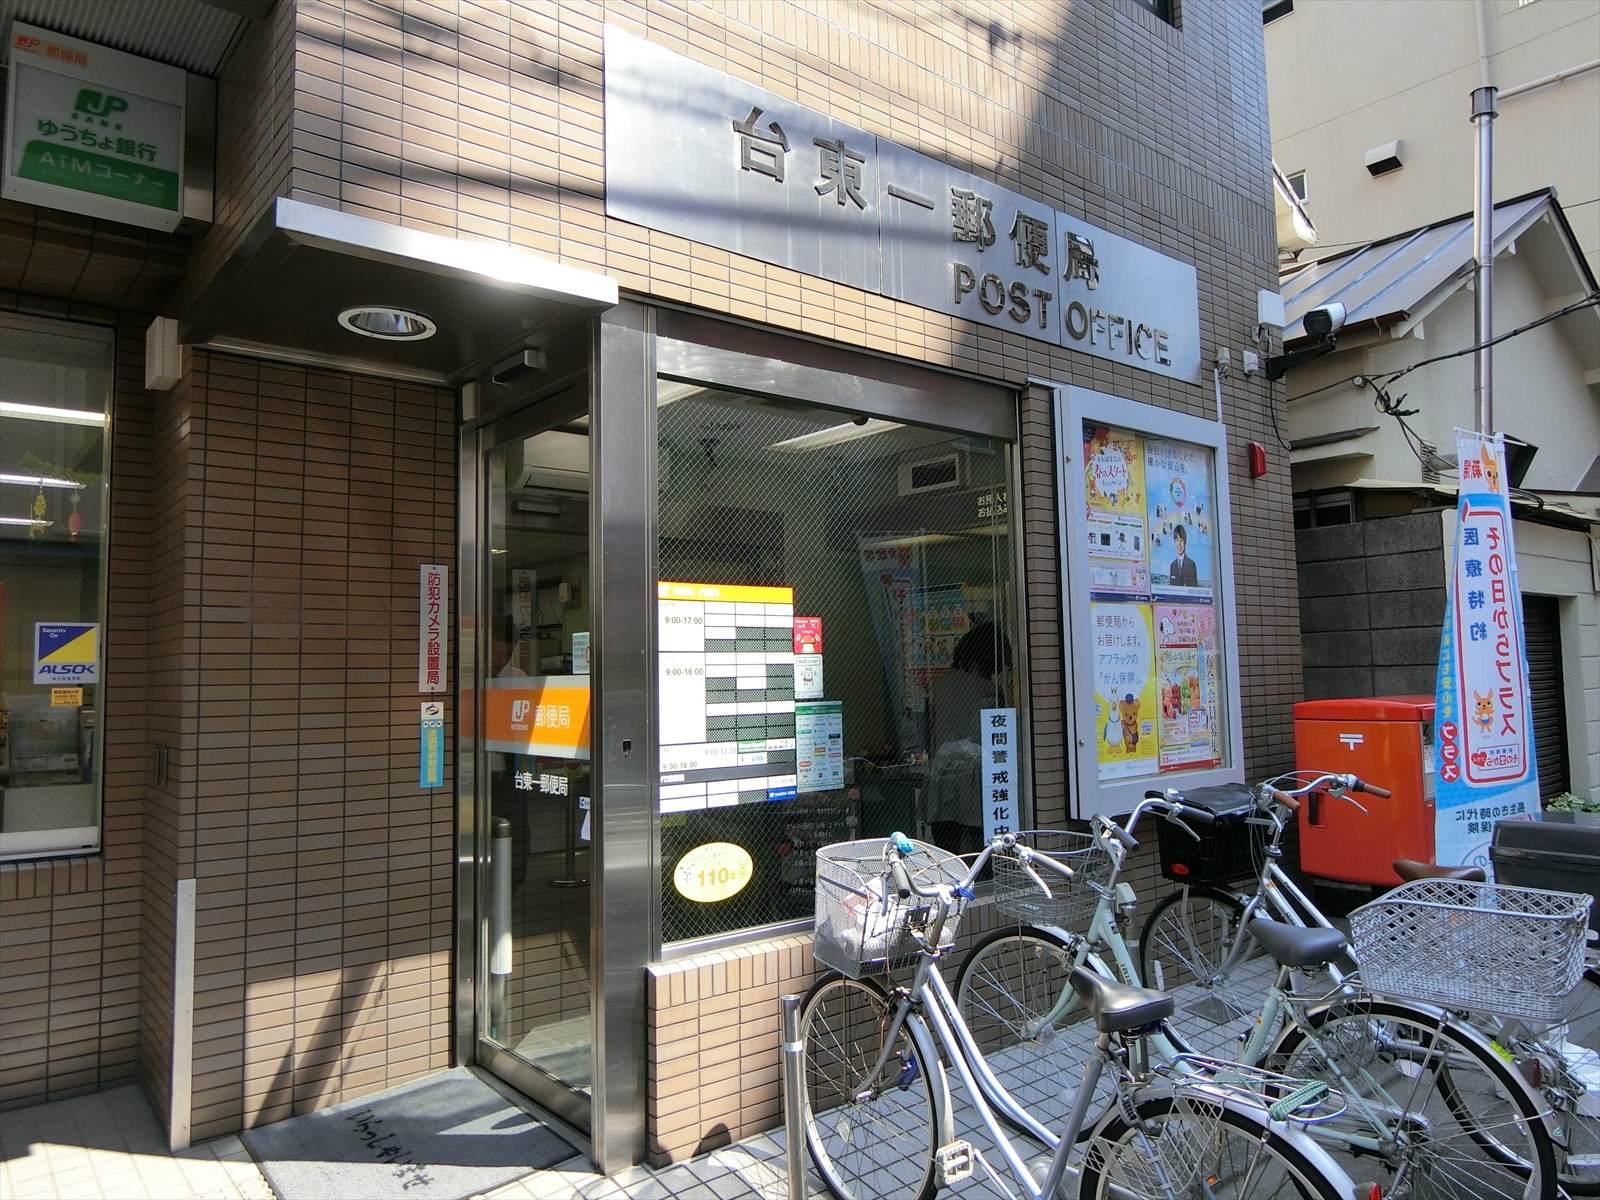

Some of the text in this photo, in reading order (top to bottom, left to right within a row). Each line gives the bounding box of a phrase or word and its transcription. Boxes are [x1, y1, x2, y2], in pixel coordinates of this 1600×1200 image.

[46, 45, 88, 67] 郵便局
[71, 112, 124, 131] BANK
[38, 119, 157, 162] ゆうちょ銀行
[39, 152, 166, 188] ATMコーナー
[732, 105, 1100, 291] 台東一郵便局
[954, 262, 1172, 367] POST OFFICE
[1094, 463, 1127, 478] 春のスタート
[427, 572, 441, 685] 防犯カメラ設置局
[664, 616, 703, 625] 9:00-17:00
[1096, 615, 1135, 628] 郵便局から
[1199, 617, 1213, 631] 東京
[1097, 635, 1142, 648] お届けします。
[38, 664, 95, 674] ALSOK
[1098, 654, 1139, 666] アフラックの
[666, 668, 704, 676] 9:00-16:00
[1099, 671, 1143, 685] 「がん保険」。
[534, 705, 570, 729] 郵便局
[514, 770, 569, 797] 台東一郵便局
[990, 714, 1010, 837] 夜間警戒強化中
